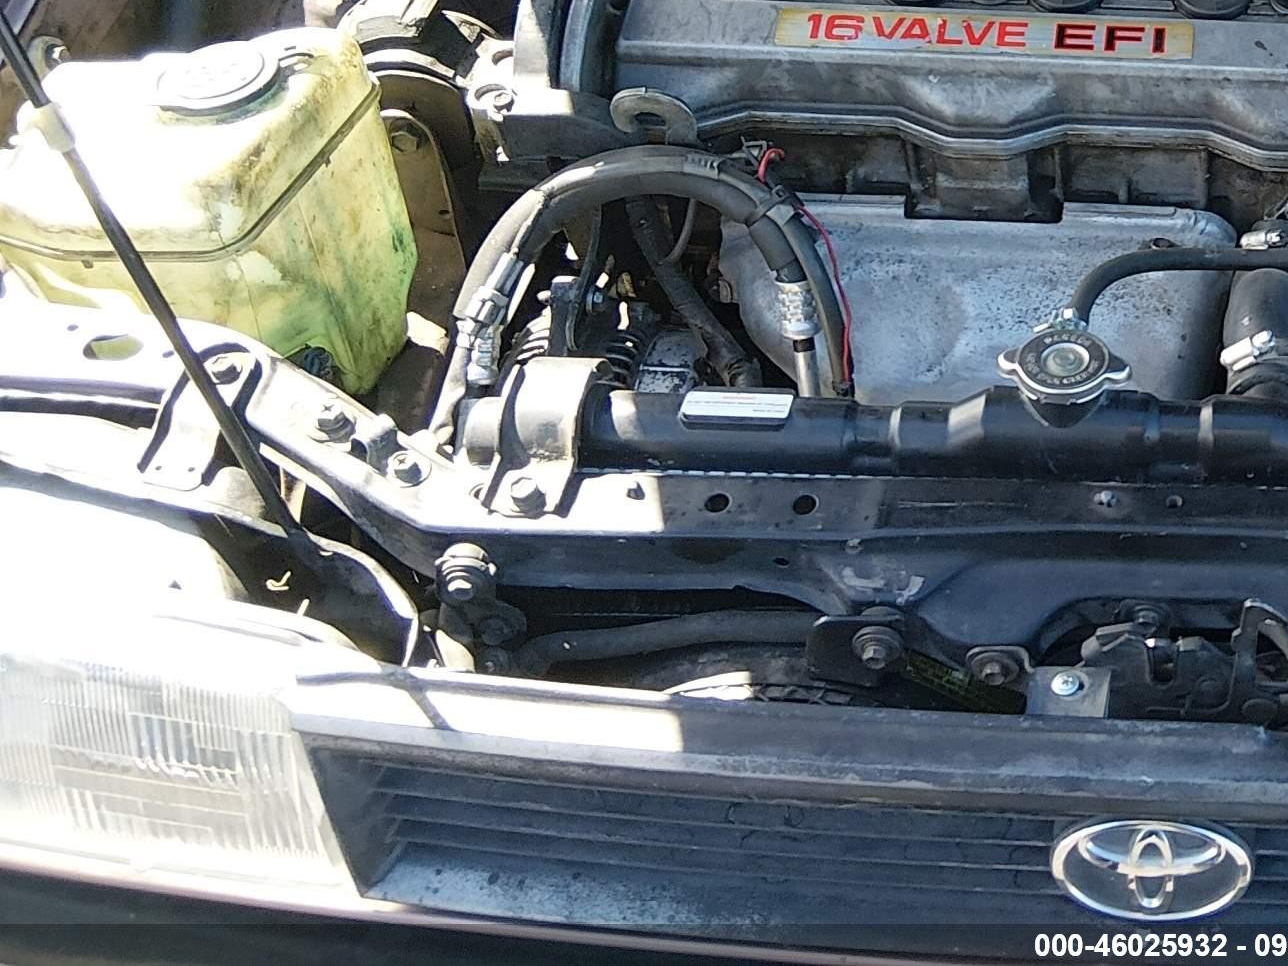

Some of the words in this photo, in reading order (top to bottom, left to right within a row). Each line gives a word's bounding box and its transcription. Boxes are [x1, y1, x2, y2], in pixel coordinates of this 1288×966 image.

[807, 13, 866, 41] 16
[871, 15, 1030, 48] VALVE
[1053, 22, 1167, 54] EFI
